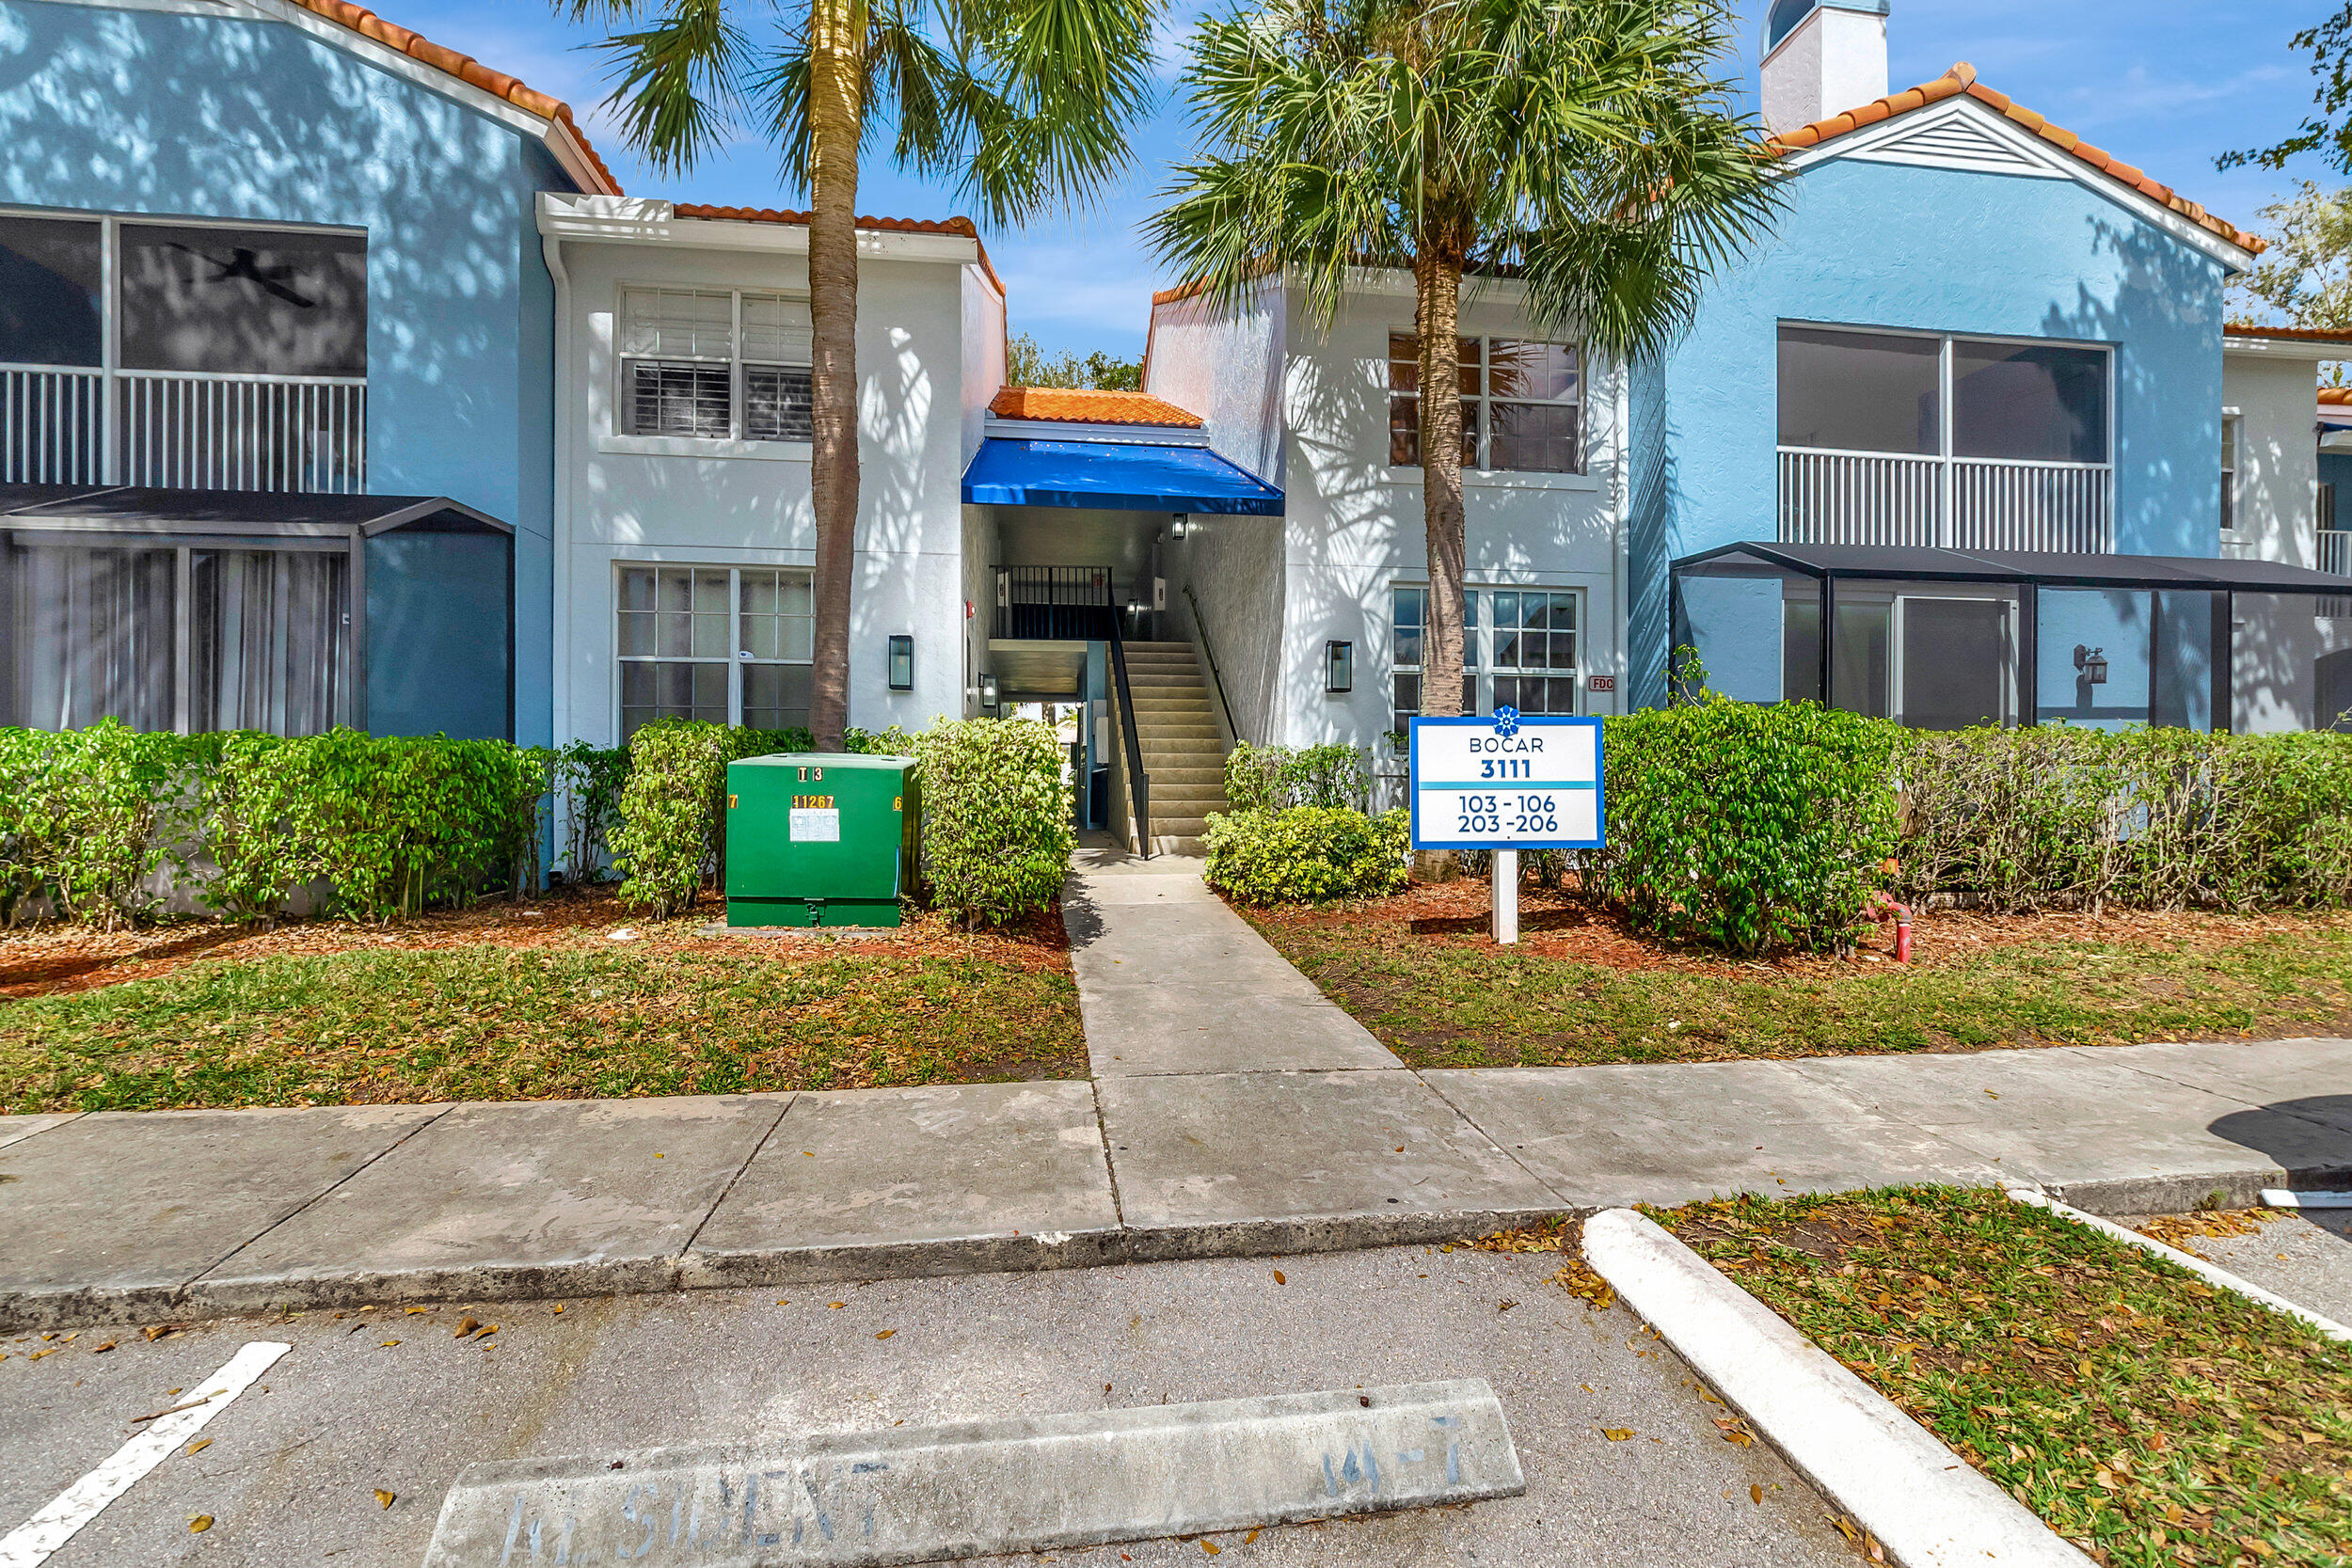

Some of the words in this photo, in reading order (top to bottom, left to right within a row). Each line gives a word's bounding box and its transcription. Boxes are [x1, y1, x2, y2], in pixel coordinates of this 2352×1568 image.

[1594, 678, 1613, 689] FDC
[1470, 737, 1544, 753] BOCAR
[815, 767, 823, 781] 3
[1480, 759, 1531, 779] 3111
[728, 794, 739, 809] 7
[792, 795, 834, 809] 11267
[894, 796, 903, 810] 6
